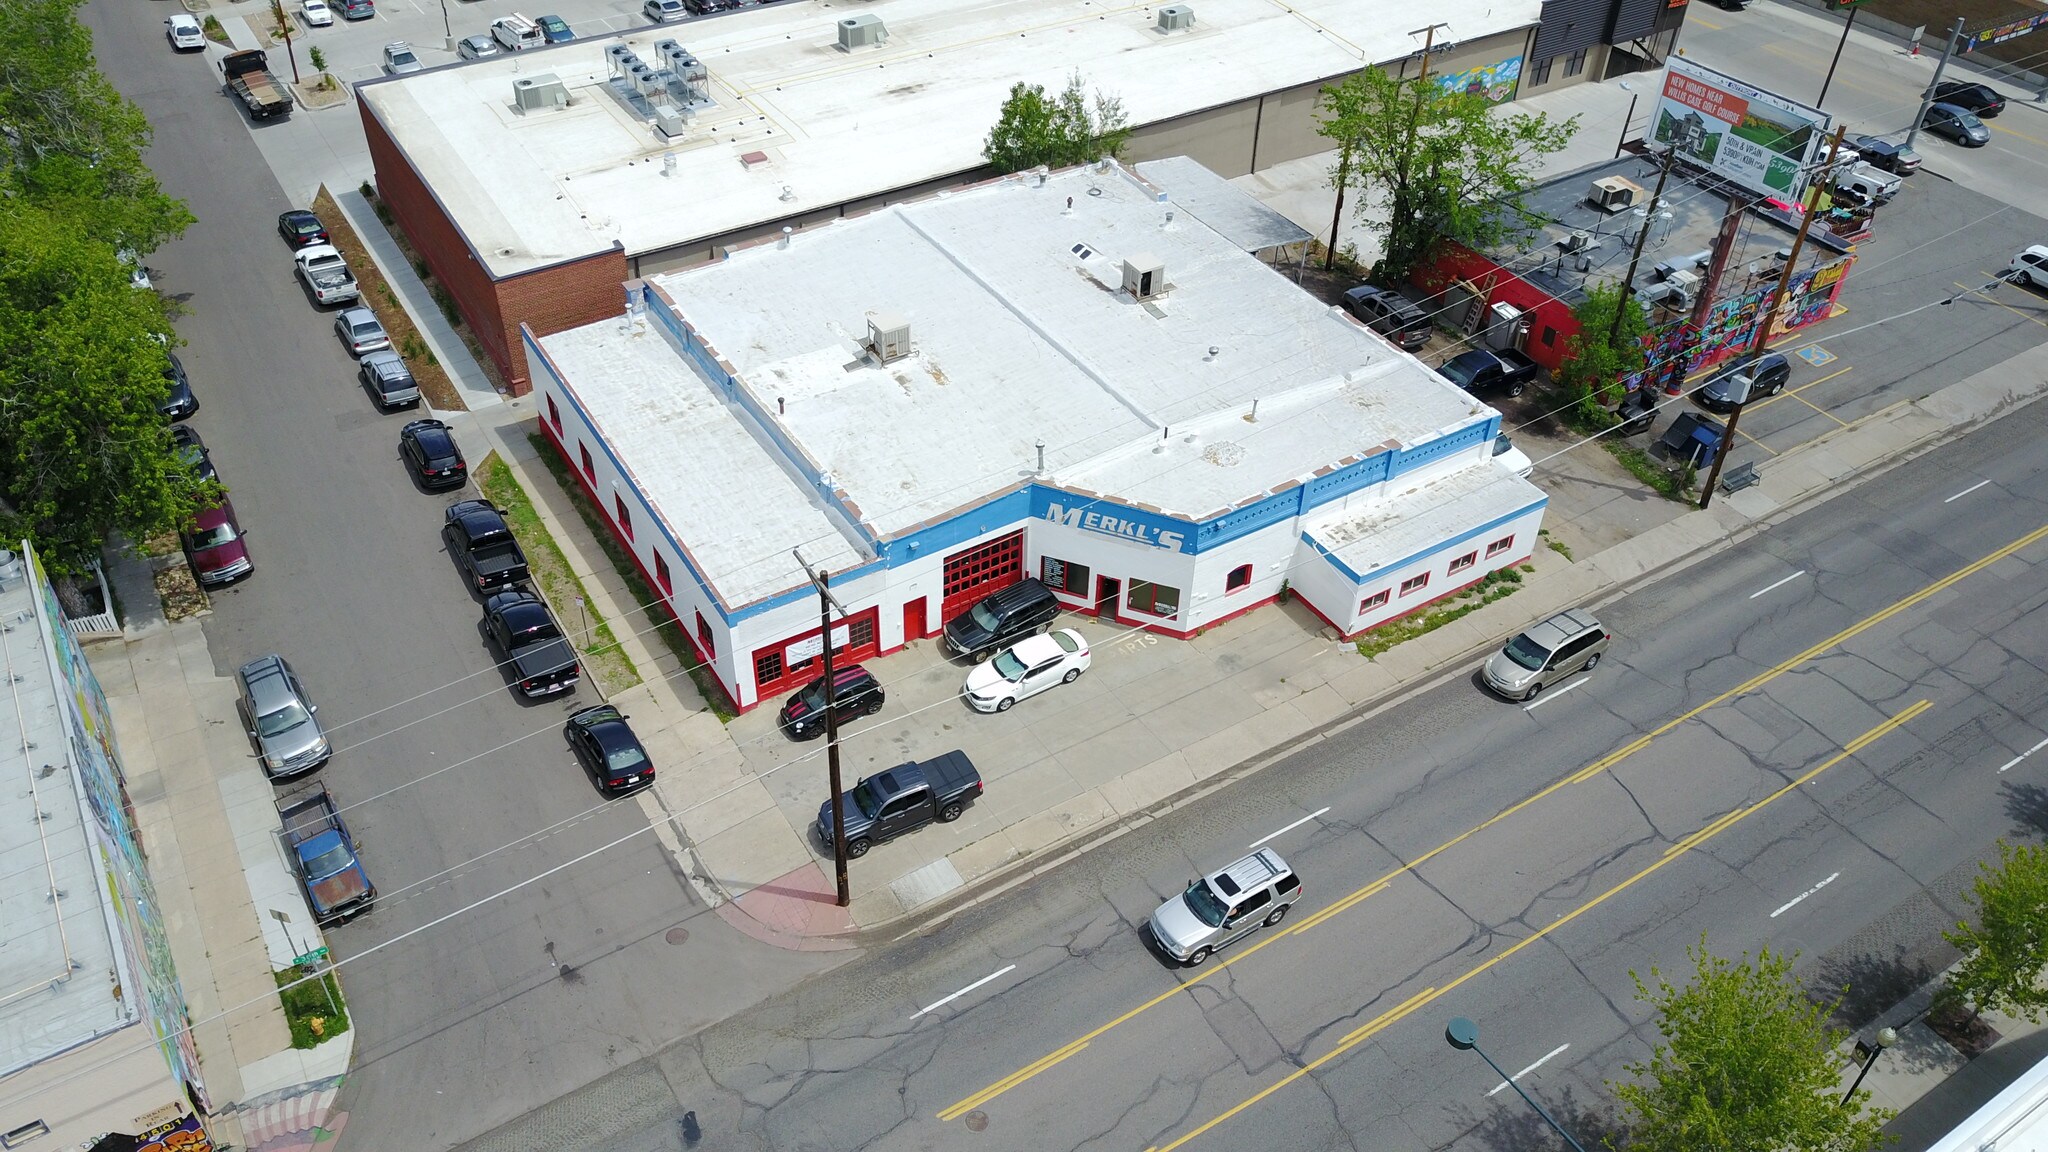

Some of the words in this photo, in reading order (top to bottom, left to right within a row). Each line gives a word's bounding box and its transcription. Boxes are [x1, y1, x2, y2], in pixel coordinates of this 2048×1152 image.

[1668, 87, 1687, 101] WILLIS
[1687, 94, 1703, 108] CASE
[1702, 101, 1717, 113] GOLF
[1717, 106, 1741, 123] COURSE
[1670, 76, 1686, 89] NEW
[1686, 82, 1707, 97] HOMES
[1706, 90, 1724, 104] NEAR
[1769, 160, 1794, 174] 5390
[1045, 502, 1185, 553] MERKL'S
